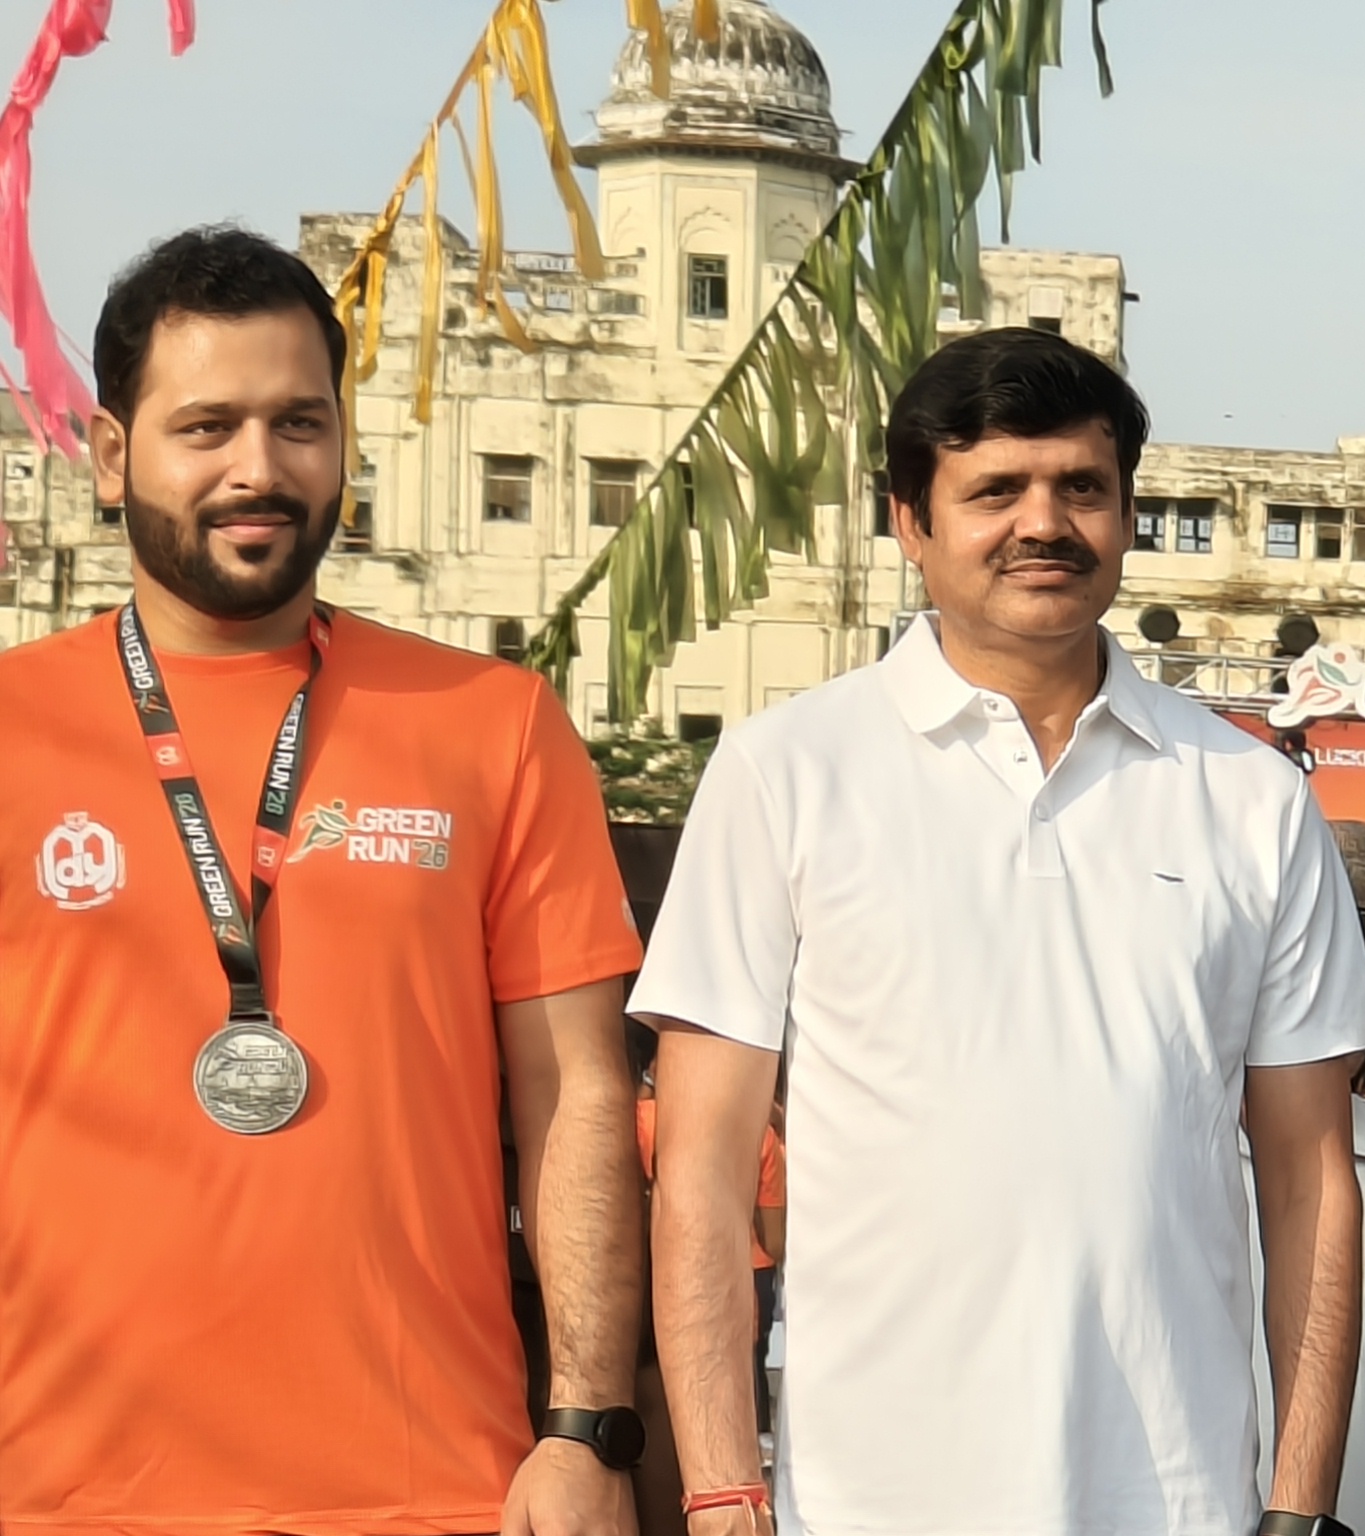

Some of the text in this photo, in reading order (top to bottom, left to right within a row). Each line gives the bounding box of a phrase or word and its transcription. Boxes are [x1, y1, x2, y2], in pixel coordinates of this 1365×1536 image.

[181, 817, 216, 855] RUN
[356, 806, 452, 839] GREEN
[347, 835, 410, 864] RUN
[195, 856, 233, 918] GREEN
